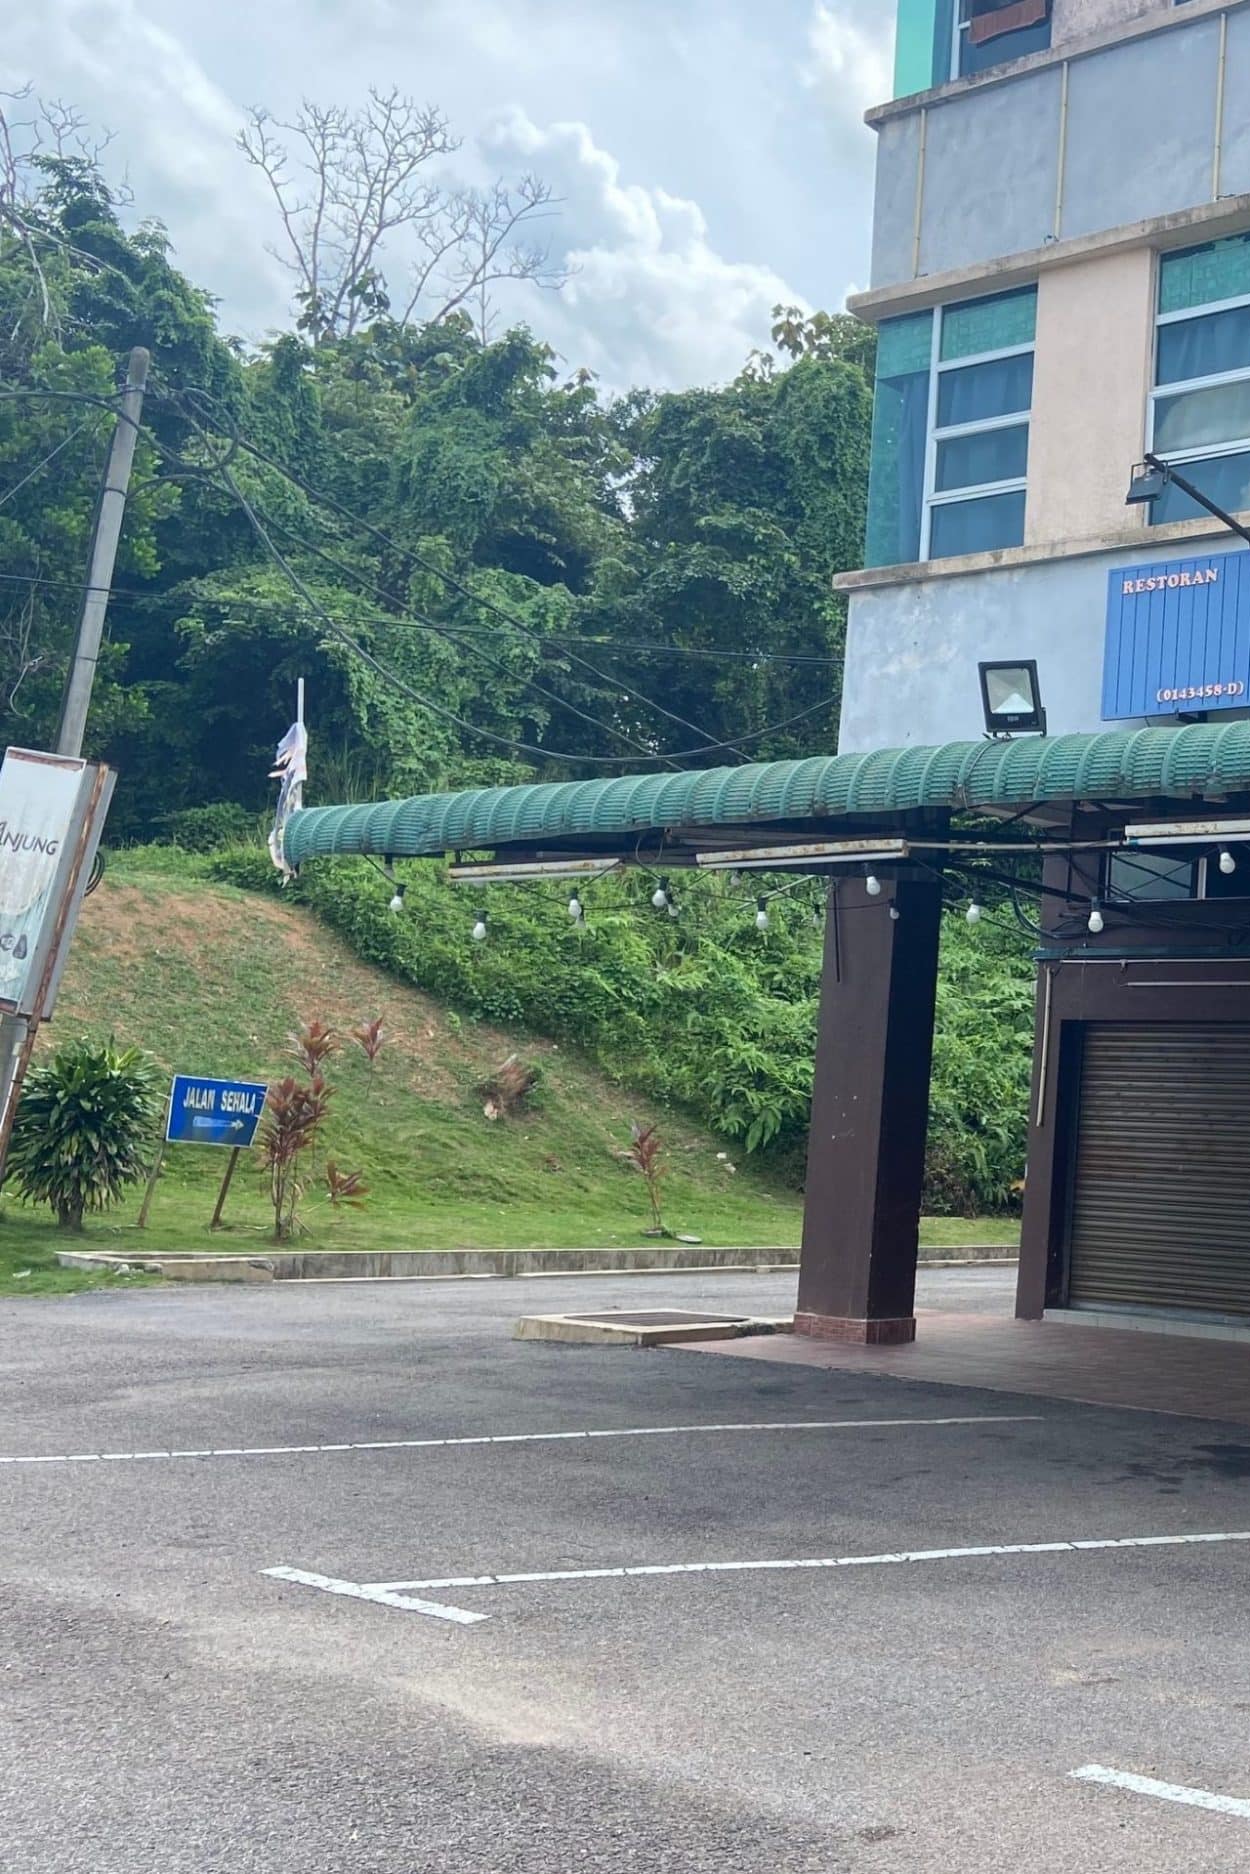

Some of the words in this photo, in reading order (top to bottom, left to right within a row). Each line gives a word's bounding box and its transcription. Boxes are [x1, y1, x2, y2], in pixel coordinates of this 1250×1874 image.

[1122, 568, 1218, 594] RESTORAN
[1156, 681, 1244, 702] (0143458-D)
[183, 1086, 216, 1110] JALAN
[220, 1089, 256, 1114] SEHALA
